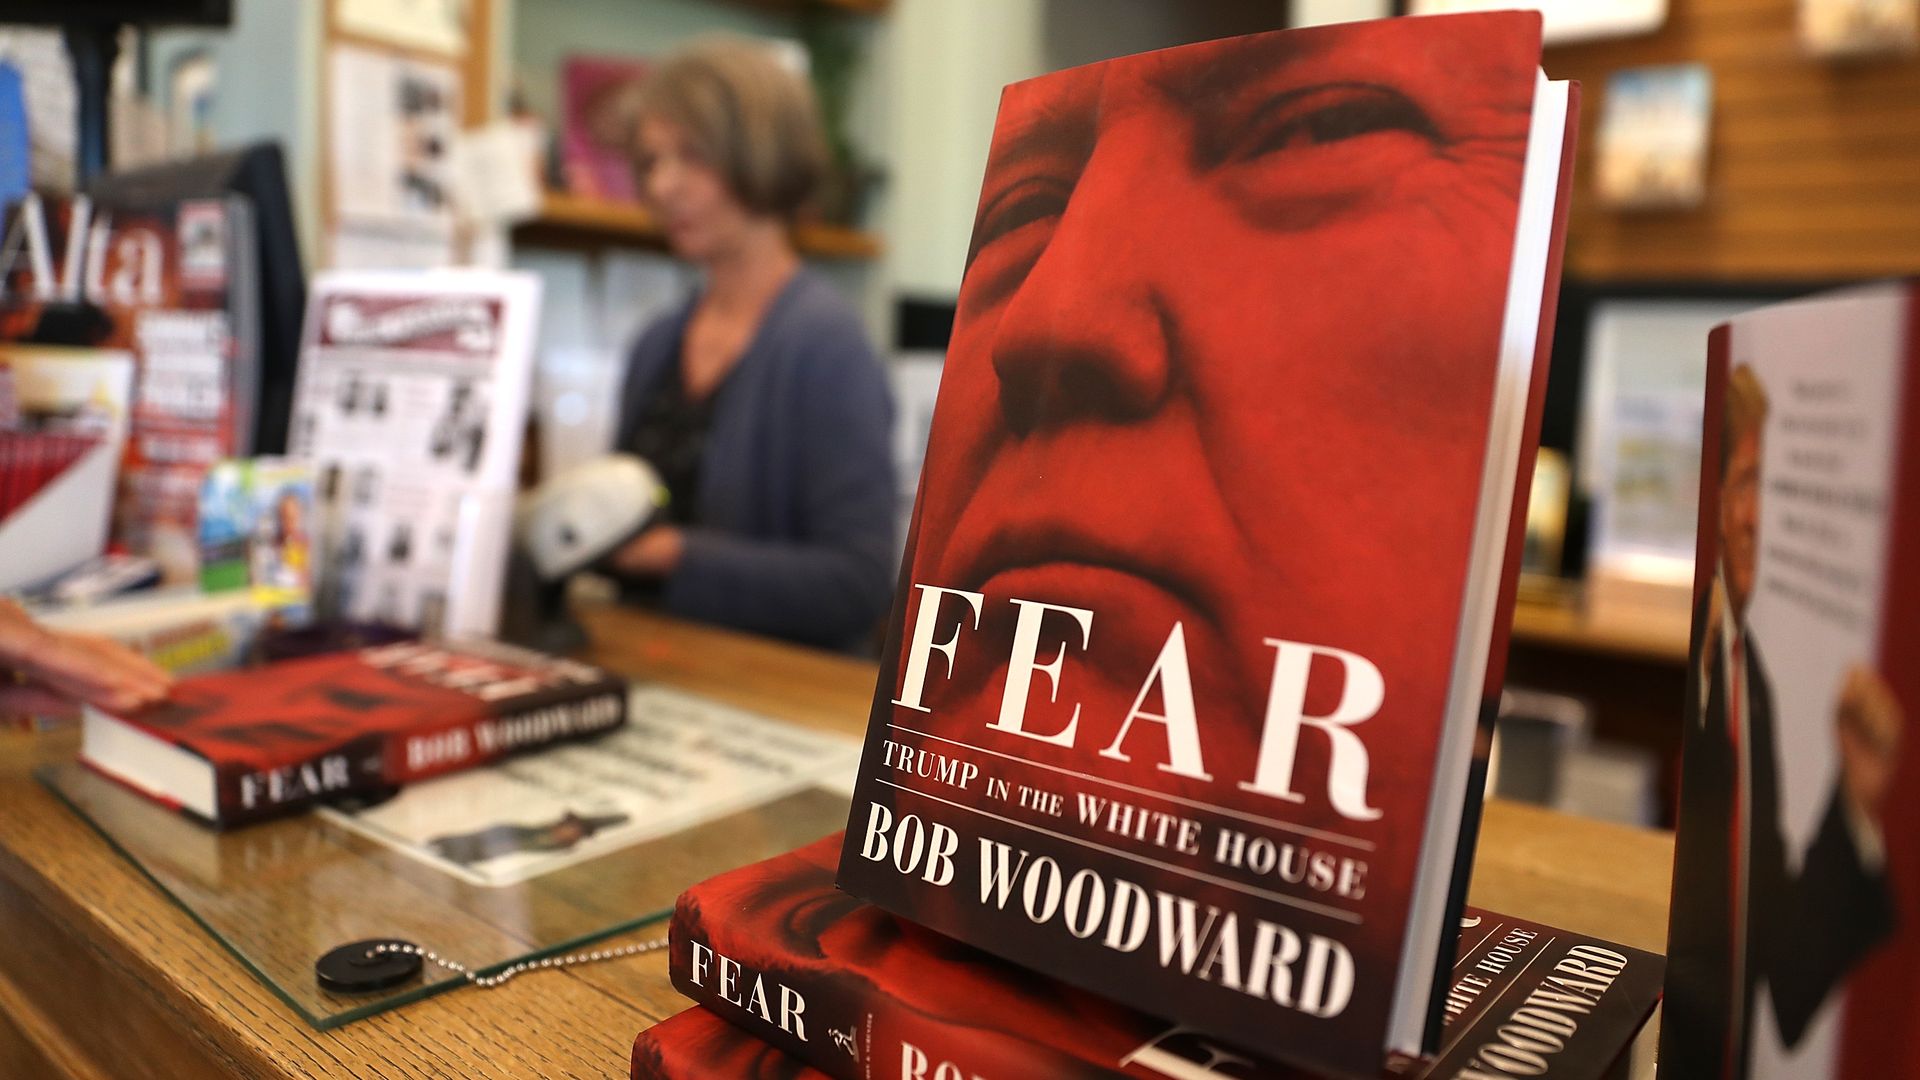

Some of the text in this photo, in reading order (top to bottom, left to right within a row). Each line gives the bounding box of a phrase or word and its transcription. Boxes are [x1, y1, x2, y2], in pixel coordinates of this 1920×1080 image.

[407, 728, 471, 771] BOB
[474, 694, 622, 752] WOODWARD
[891, 583, 1386, 821] FEAR
[241, 754, 349, 809] FEAR
[882, 739, 1369, 901] TRUMP IN THE WHITE HOUSE
[860, 801, 1356, 1019] BOB WOODWARD
[690, 940, 809, 1042] FEAR
[1443, 973, 1492, 1026] HITE
[1476, 927, 1539, 975] HOUSE
